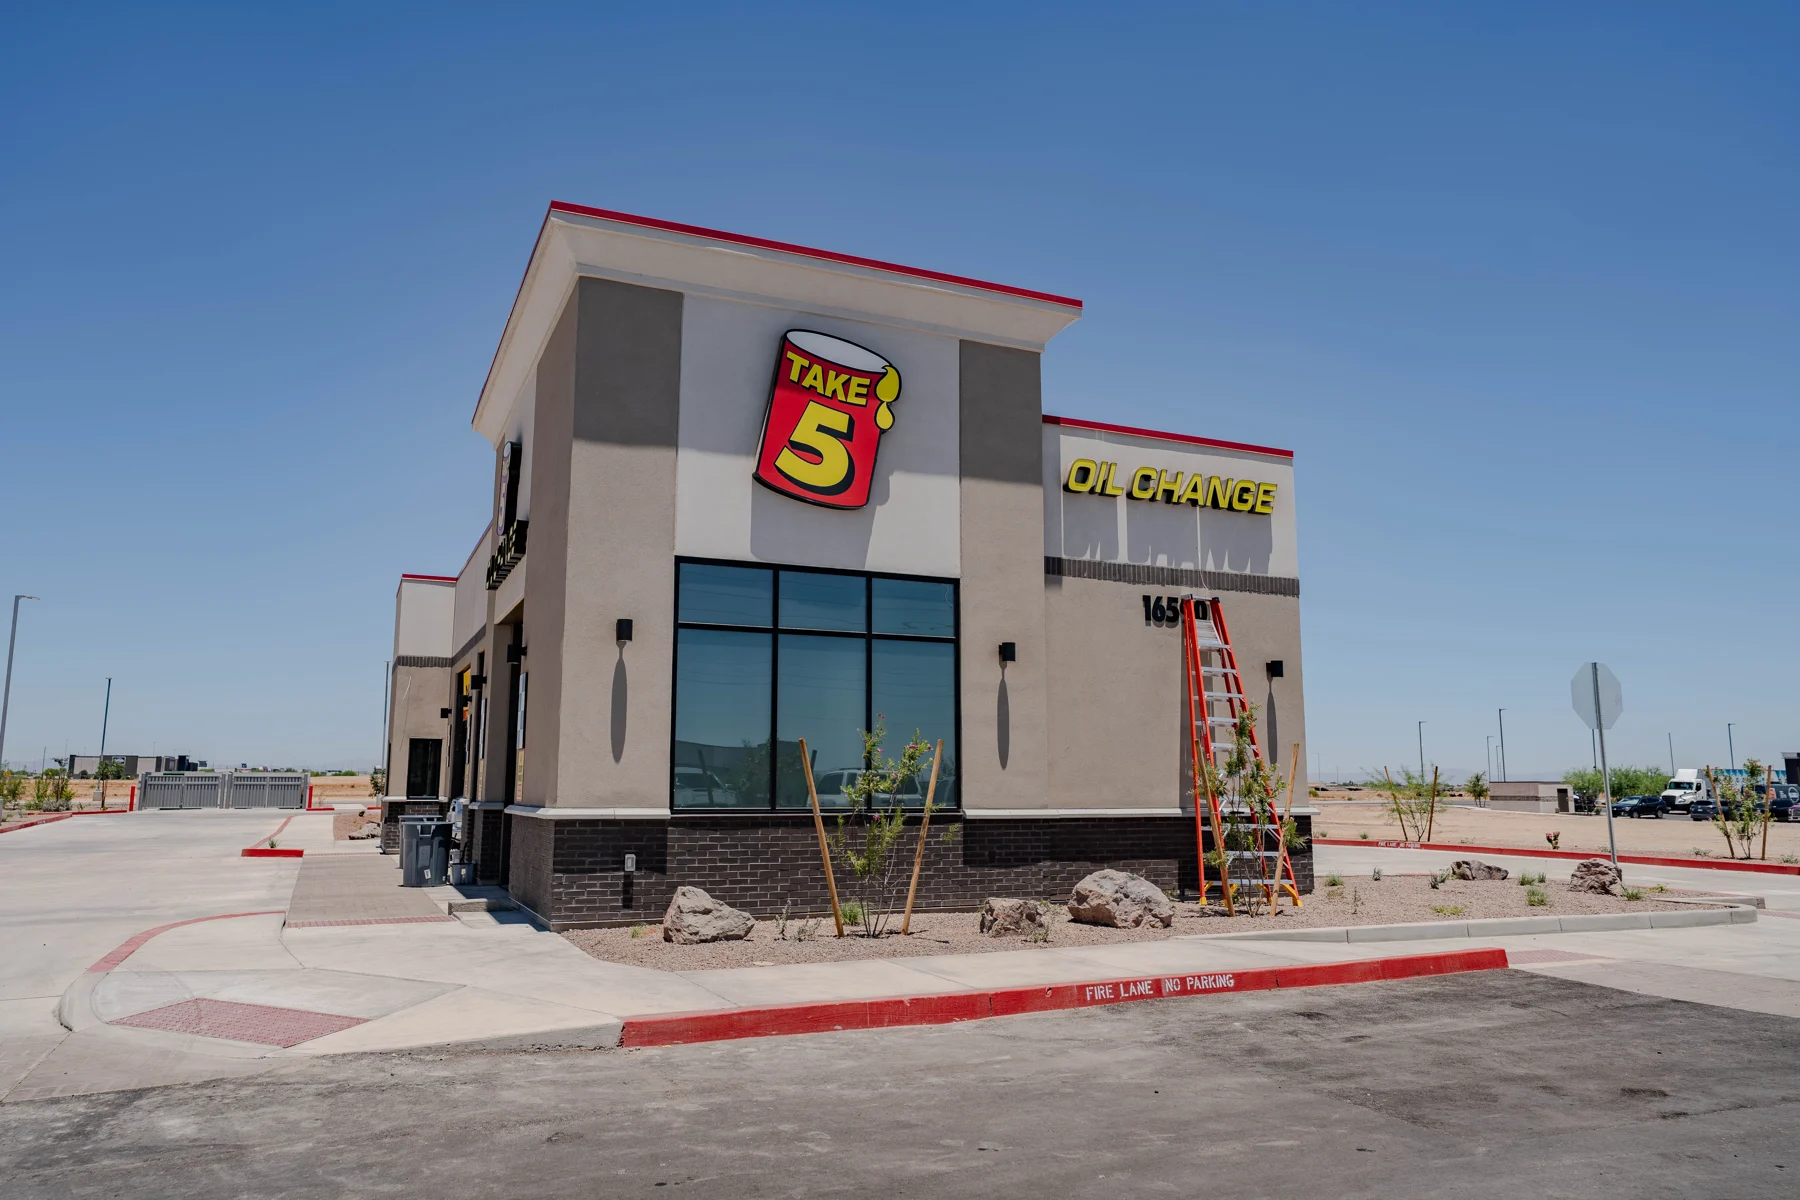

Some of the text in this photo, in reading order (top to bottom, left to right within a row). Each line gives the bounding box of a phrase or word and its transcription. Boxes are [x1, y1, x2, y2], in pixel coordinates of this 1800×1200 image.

[786, 350, 872, 408] TAKE
[774, 399, 856, 496] 5
[1065, 458, 1278, 515] OIL CHANGE
[1085, 974, 1235, 1001] FIRE LANE NO PARKING
